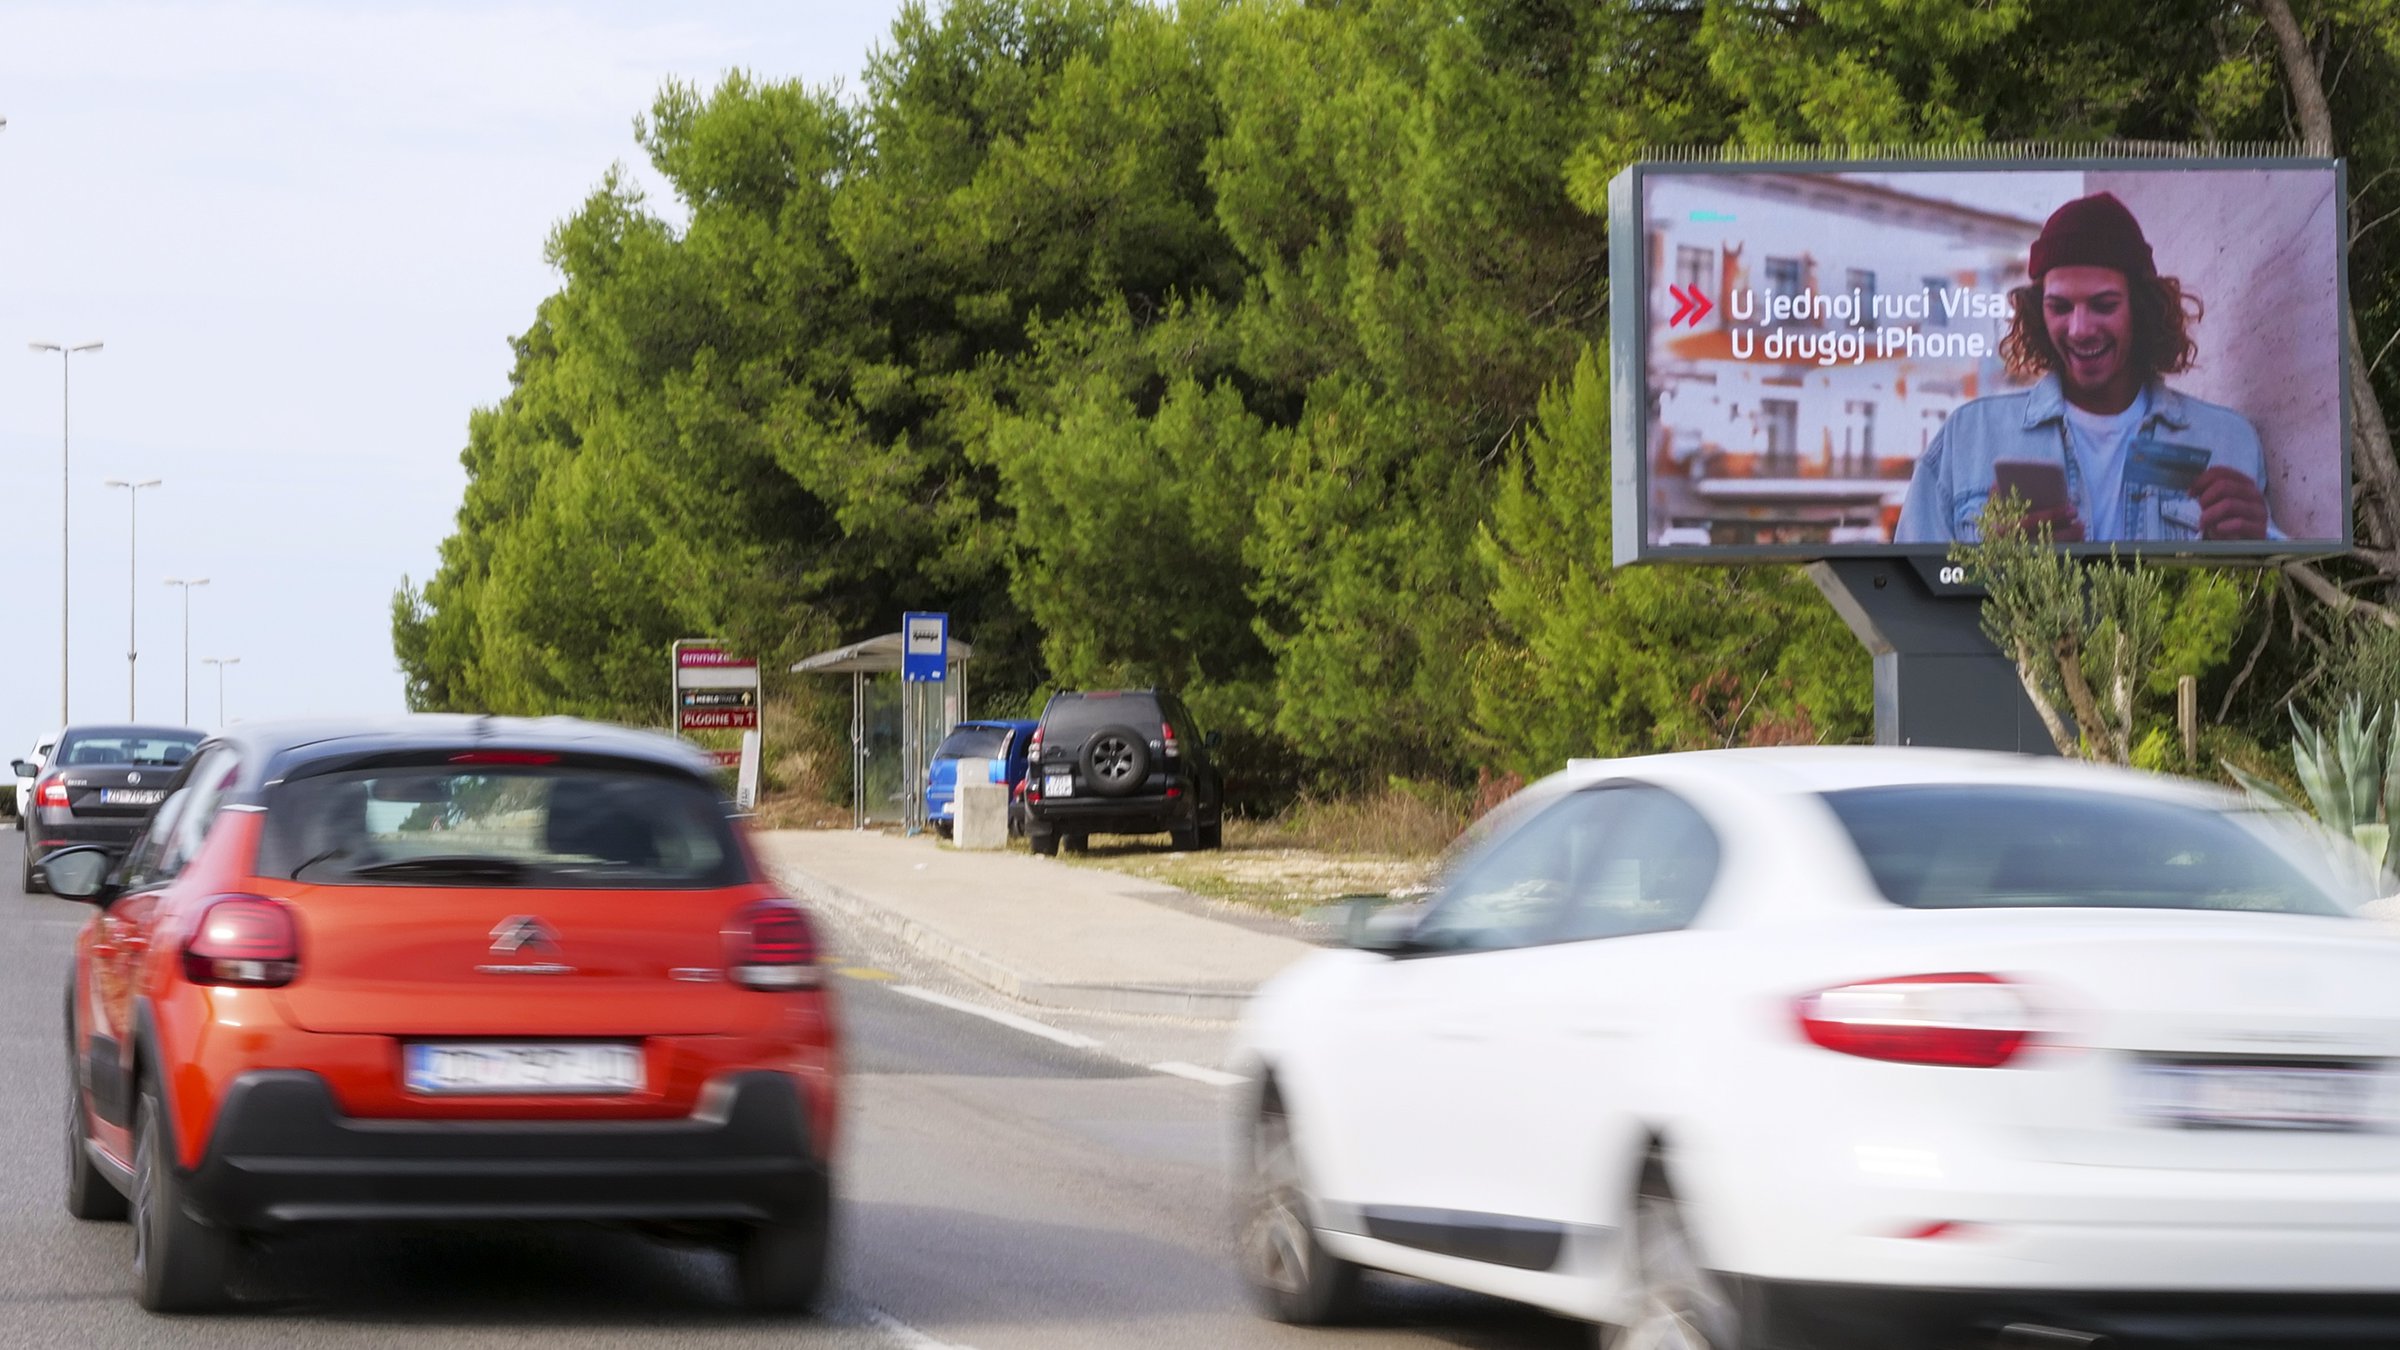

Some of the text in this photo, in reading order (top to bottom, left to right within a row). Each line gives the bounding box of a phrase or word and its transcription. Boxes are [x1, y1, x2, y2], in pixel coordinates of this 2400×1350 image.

[1731, 287, 2016, 326] U jednoj ruci Visa.
[1731, 326, 1993, 366] U drugoj iPhone.
[684, 712, 730, 727] PLODINE
